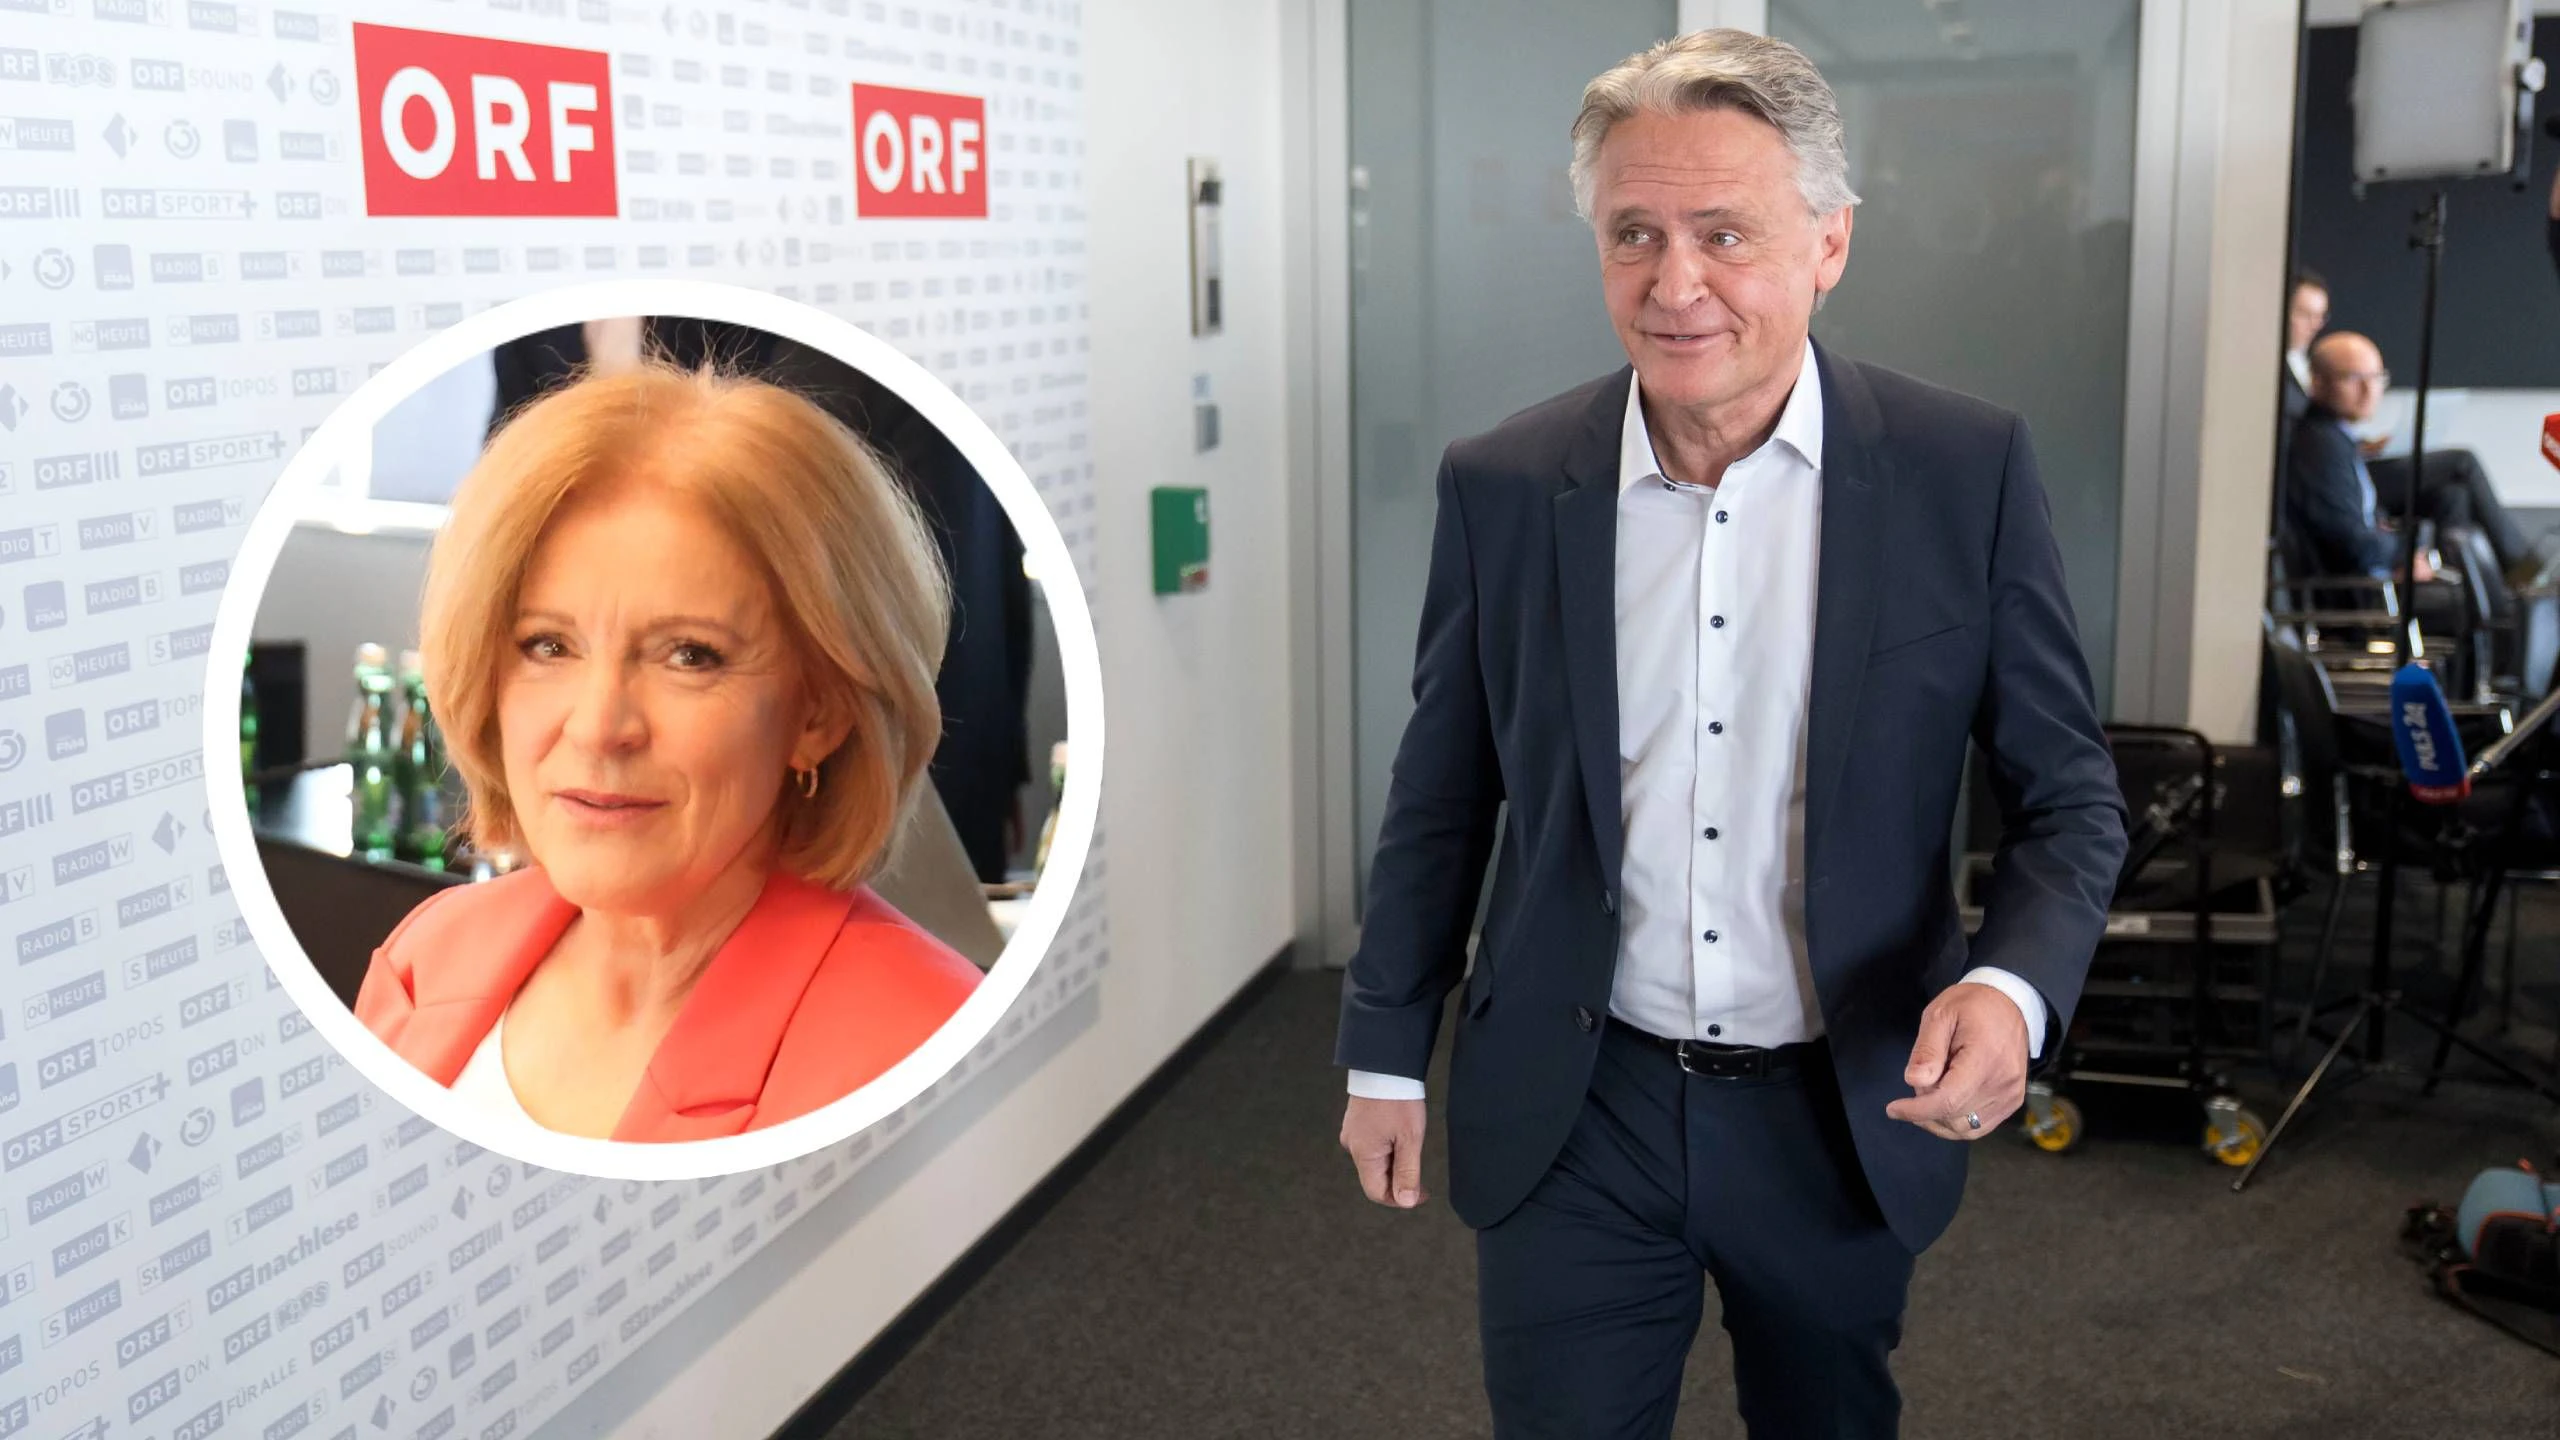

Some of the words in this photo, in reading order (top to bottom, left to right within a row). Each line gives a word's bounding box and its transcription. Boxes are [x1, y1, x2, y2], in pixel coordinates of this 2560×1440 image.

[3, 53, 35, 75] RF
[135, 65, 180, 87] ORF
[188, 68, 254, 91] SOUND
[20, 126, 70, 143] HEUTE
[379, 64, 600, 184] ORF
[862, 108, 980, 195] ORF
[105, 194, 155, 214] ORF
[161, 190, 258, 219] SPORT+
[279, 196, 318, 216] ORF
[154, 261, 199, 276] RADIO
[100, 326, 148, 344] HEUTE
[193, 320, 237, 337] HEUTE
[169, 382, 213, 404] ORF
[220, 377, 278, 399] TOPOS
[295, 373, 334, 392] ORF
[140, 447, 186, 470] ORF
[194, 431, 287, 464] SPORT+
[38, 459, 89, 484] ORF
[83, 520, 131, 541] RADIO
[138, 516, 151, 533] V
[177, 507, 221, 527] RADIO
[0, 537, 30, 555] DIO
[40, 531, 52, 552] T
[89, 584, 137, 606] RADIO
[145, 578, 157, 598] B
[184, 568, 227, 588] RADIO
[154, 640, 165, 658] S
[172, 632, 211, 652] HEUT
[53, 659, 74, 680] OÖ
[78, 650, 128, 674] HEUTE
[108, 706, 157, 733] ORF
[163, 693, 203, 719] TOP
[75, 777, 124, 808] ORF
[133, 755, 204, 792] SPORT
[58, 850, 105, 878] RADIO
[110, 839, 130, 860] W
[13, 872, 26, 893] V
[121, 893, 168, 918] RADIO
[174, 882, 188, 901] K
[22, 926, 71, 957] RADIO
[80, 916, 94, 937] B
[130, 962, 142, 982] S
[149, 943, 196, 973] HEUTE
[27, 997, 49, 1020] OÖ
[52, 979, 103, 1012] HEUTE
[184, 990, 227, 1021] ORF
[281, 1011, 311, 1036] OR
[42, 1045, 92, 1081] ORF
[99, 1014, 165, 1057] TOPOS
[191, 1045, 234, 1078] ORF
[240, 1032, 266, 1057] ON
[282, 1062, 323, 1093] ORF
[7, 1126, 59, 1163] ORF
[67, 1071, 172, 1136] SPORT+
[318, 1102, 355, 1128] RADIO
[240, 1141, 281, 1172] RADIO
[327, 1154, 366, 1183] HEUTE
[32, 1182, 81, 1216] RADIO
[87, 1166, 105, 1188] W
[153, 1185, 198, 1218] RADIO
[250, 1194, 291, 1225] HEUTE
[57, 1233, 105, 1269] RADIO
[113, 1219, 127, 1240] K
[345, 1249, 385, 1282] ORF
[388, 1214, 439, 1257] SOUND
[450, 1237, 484, 1268] ORF
[142, 1267, 161, 1287] St
[163, 1238, 209, 1273] HEUTE
[14, 1272, 27, 1293] B
[210, 1273, 252, 1306] ORF
[384, 1276, 421, 1312] ORF
[49, 1318, 61, 1339] S
[69, 1288, 119, 1326] HEUTE
[120, 1321, 167, 1360] ORF
[227, 1320, 268, 1356] ORF
[313, 1326, 354, 1358] ORF
[31, 1359, 101, 1413] TOPOS
[132, 1376, 178, 1417] ORF
[184, 1354, 210, 1384] ON
[178, 1408, 221, 1440] ORF
[260, 1357, 299, 1396] ALLE
